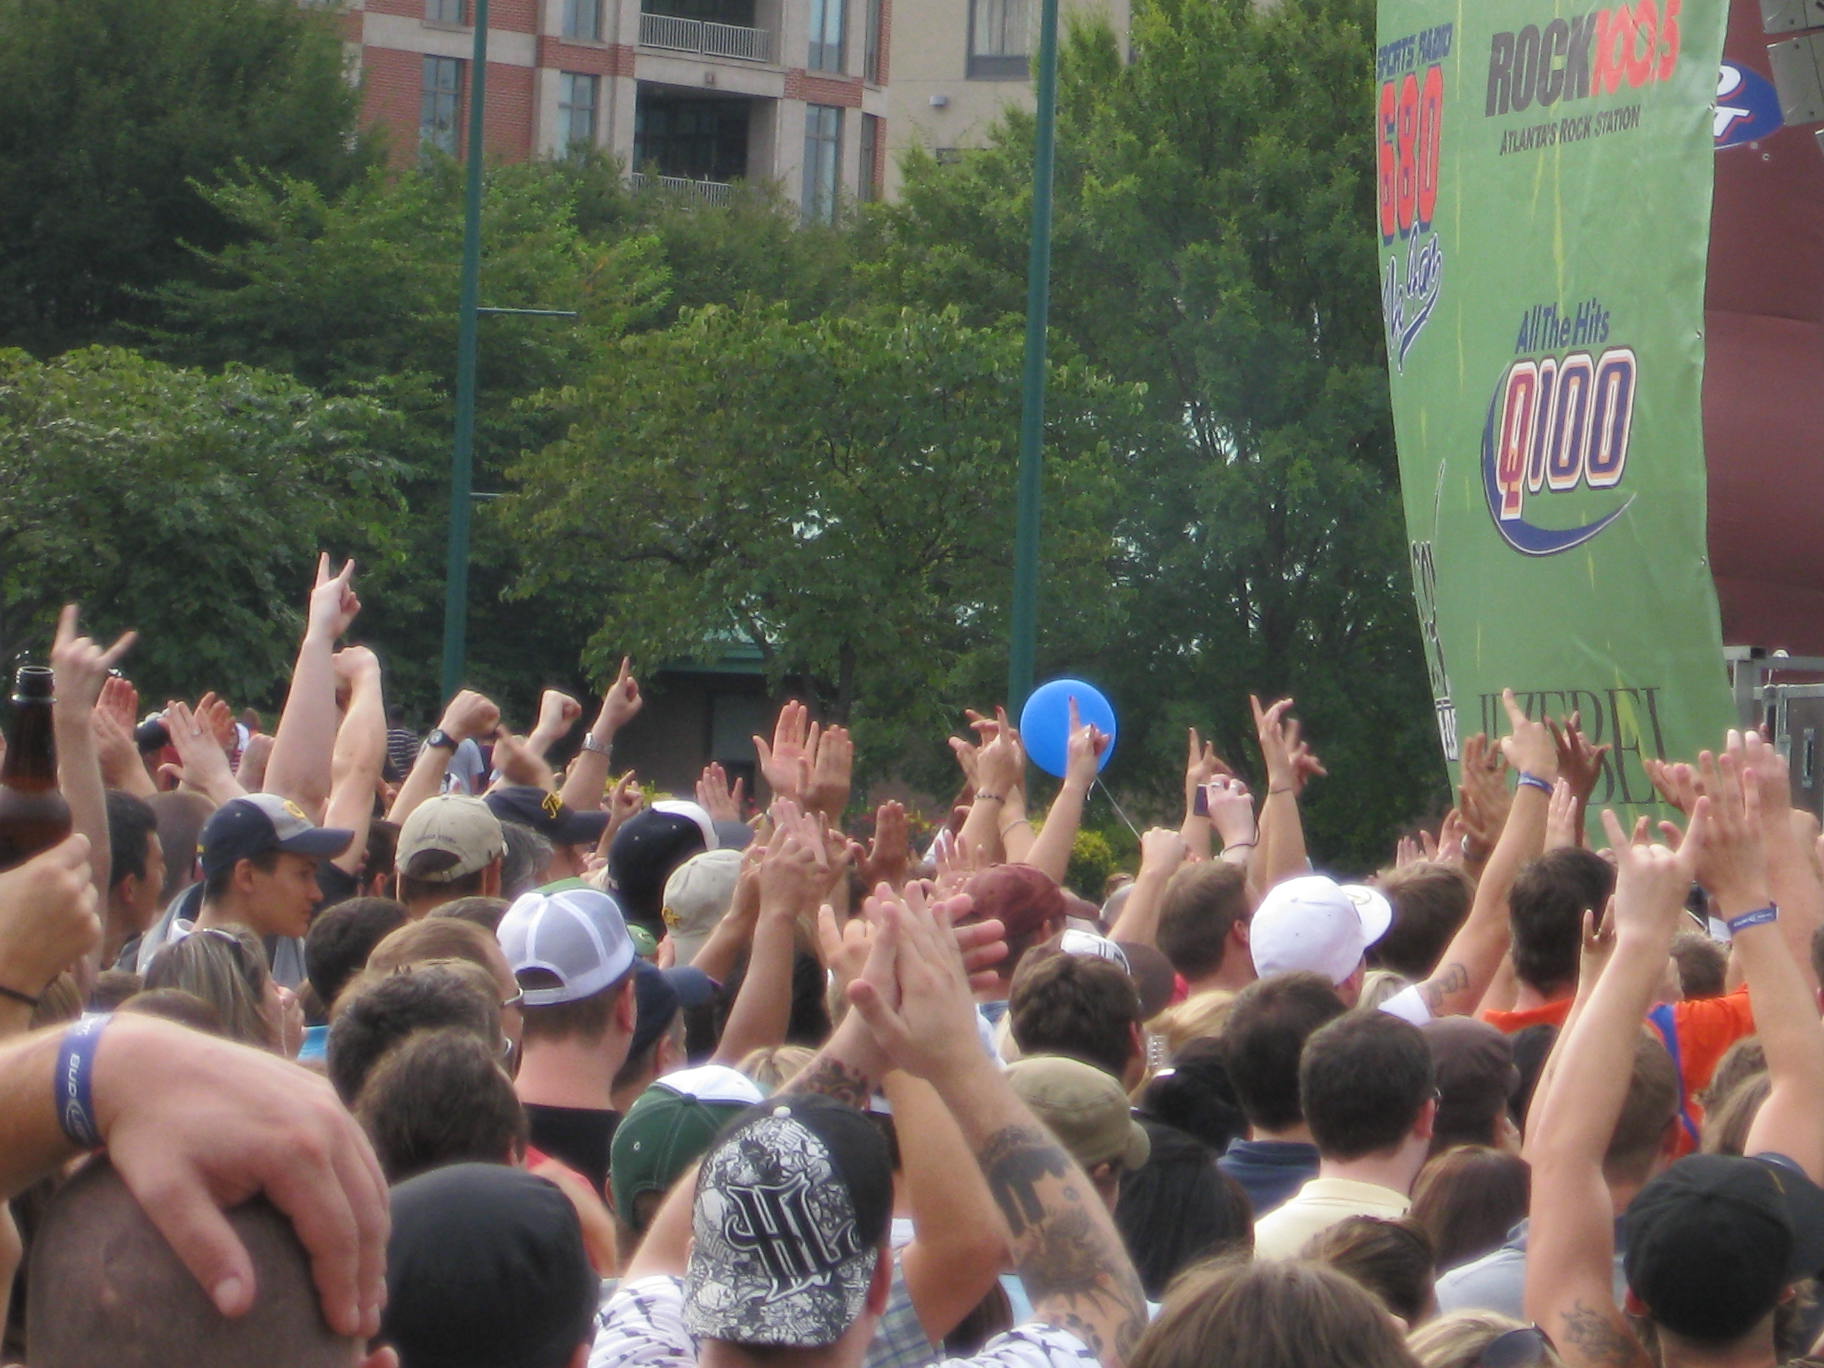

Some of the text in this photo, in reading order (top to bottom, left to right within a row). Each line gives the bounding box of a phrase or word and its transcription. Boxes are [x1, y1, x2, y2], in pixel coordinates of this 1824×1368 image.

[1499, 104, 1641, 157] ATLANTA'S ROCK STATION
[1515, 297, 1610, 354] All The Hits
[1496, 345, 1637, 521] Q100
